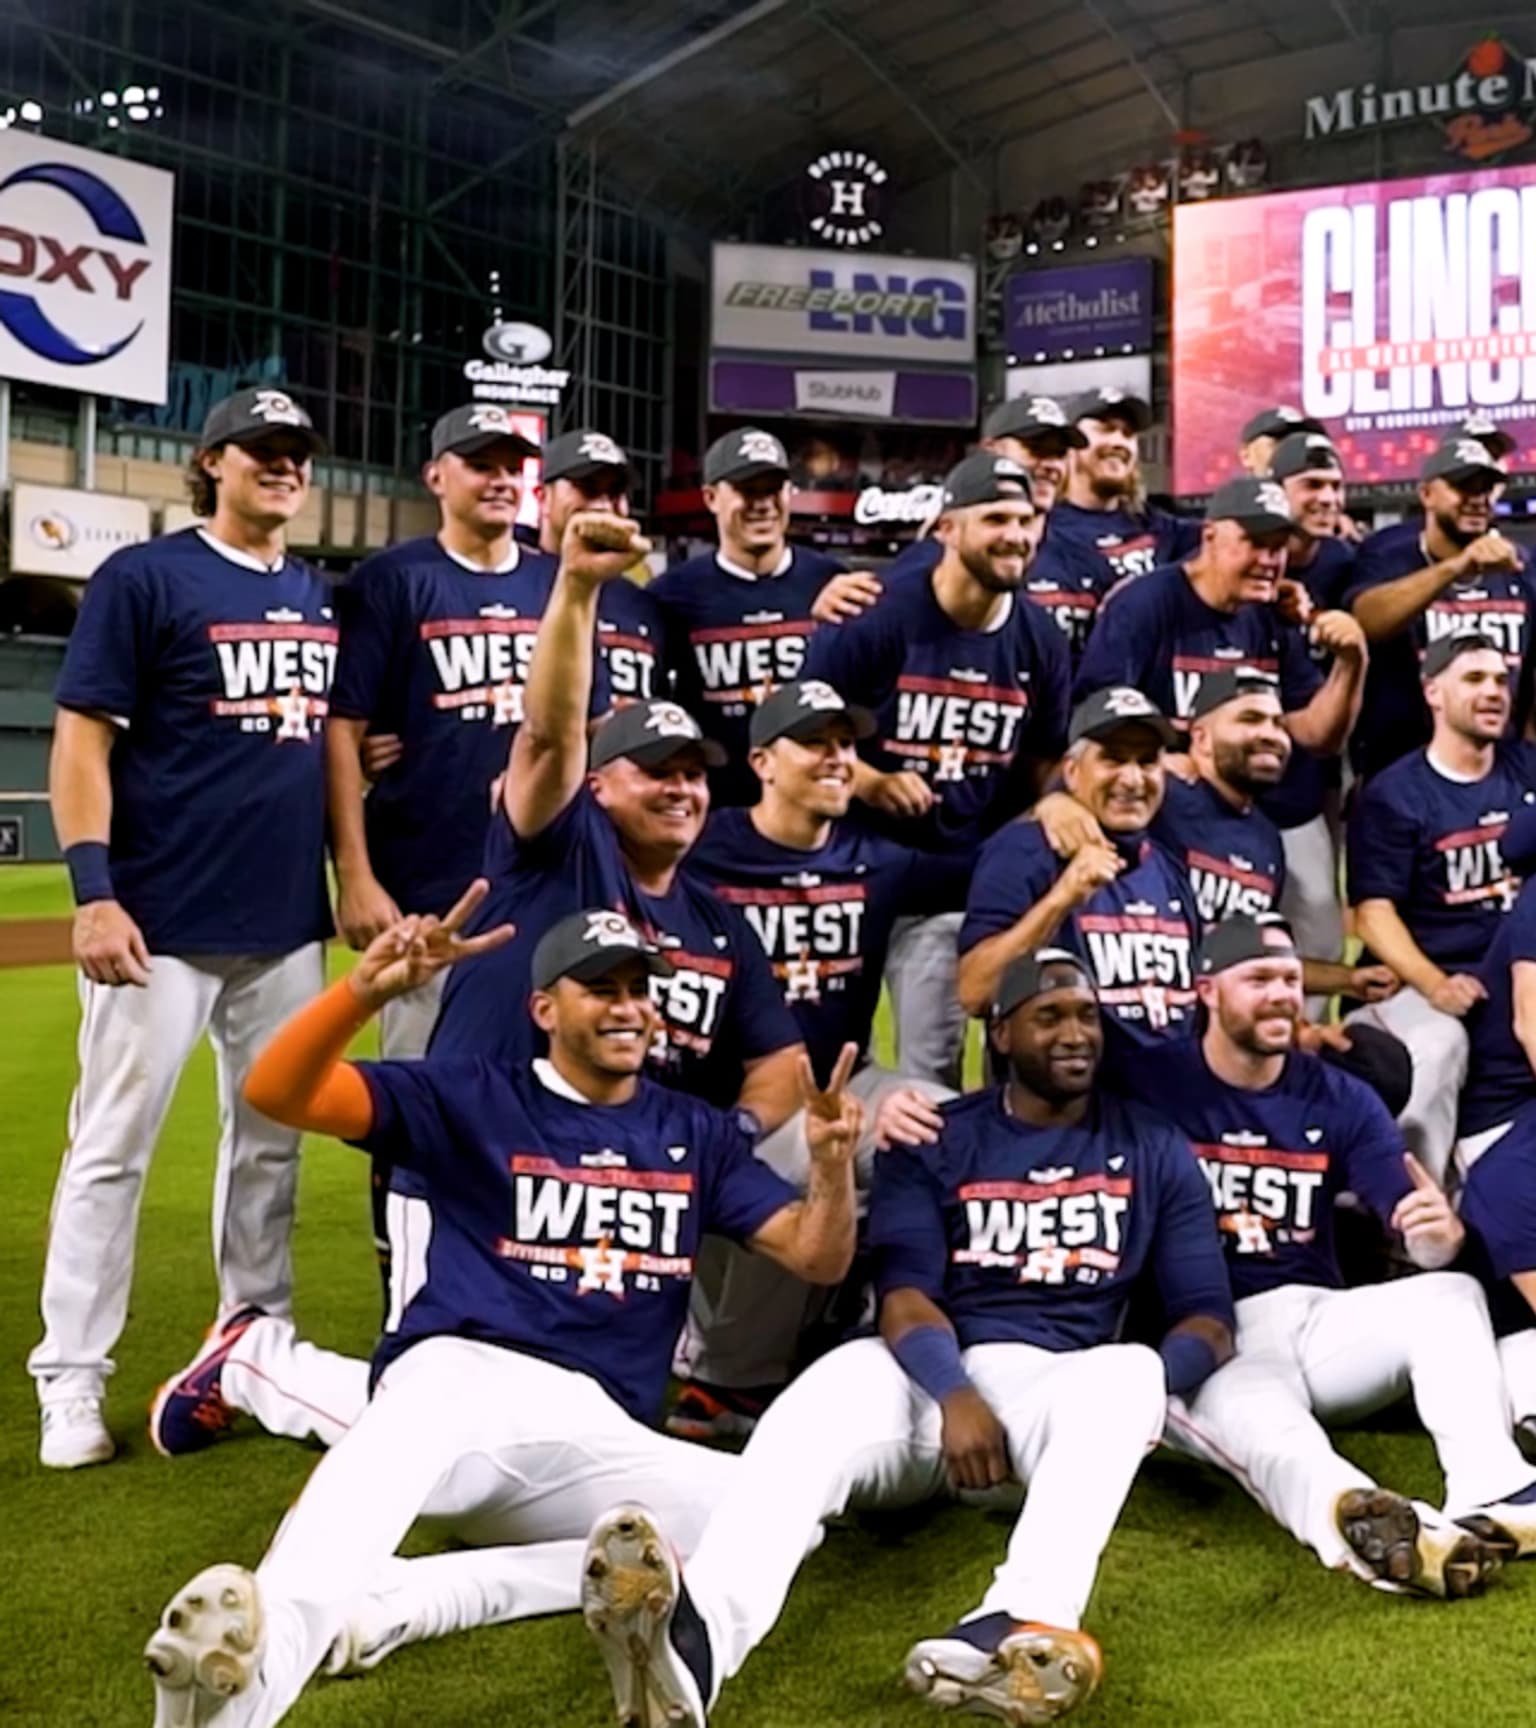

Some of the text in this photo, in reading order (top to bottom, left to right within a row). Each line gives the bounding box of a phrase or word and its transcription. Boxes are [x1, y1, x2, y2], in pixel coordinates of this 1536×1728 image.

[1305, 70, 1509, 139] Minute
[807, 151, 888, 184] HOUSTON
[830, 180, 866, 216] H
[809, 216, 882, 245] ASTROS
[0, 225, 152, 301] OXY
[726, 282, 946, 319] FREEPORT
[809, 267, 967, 341] LNG
[463, 359, 570, 388] Gallagher
[808, 379, 883, 403] StubHub
[217, 640, 340, 700] WEST
[429, 632, 540, 692] WES
[695, 635, 812, 689] WES
[275, 694, 312, 740] H
[896, 692, 1025, 751] WEST
[933, 744, 970, 782] H
[784, 958, 822, 1002] H
[1087, 932, 1191, 990] WEST
[648, 969, 726, 1036] EST
[516, 1175, 690, 1256] WEST
[966, 1190, 1129, 1254] WEST
[1232, 1212, 1273, 1254] H
[576, 1245, 629, 1296] H
[1019, 1247, 1071, 1284] H
